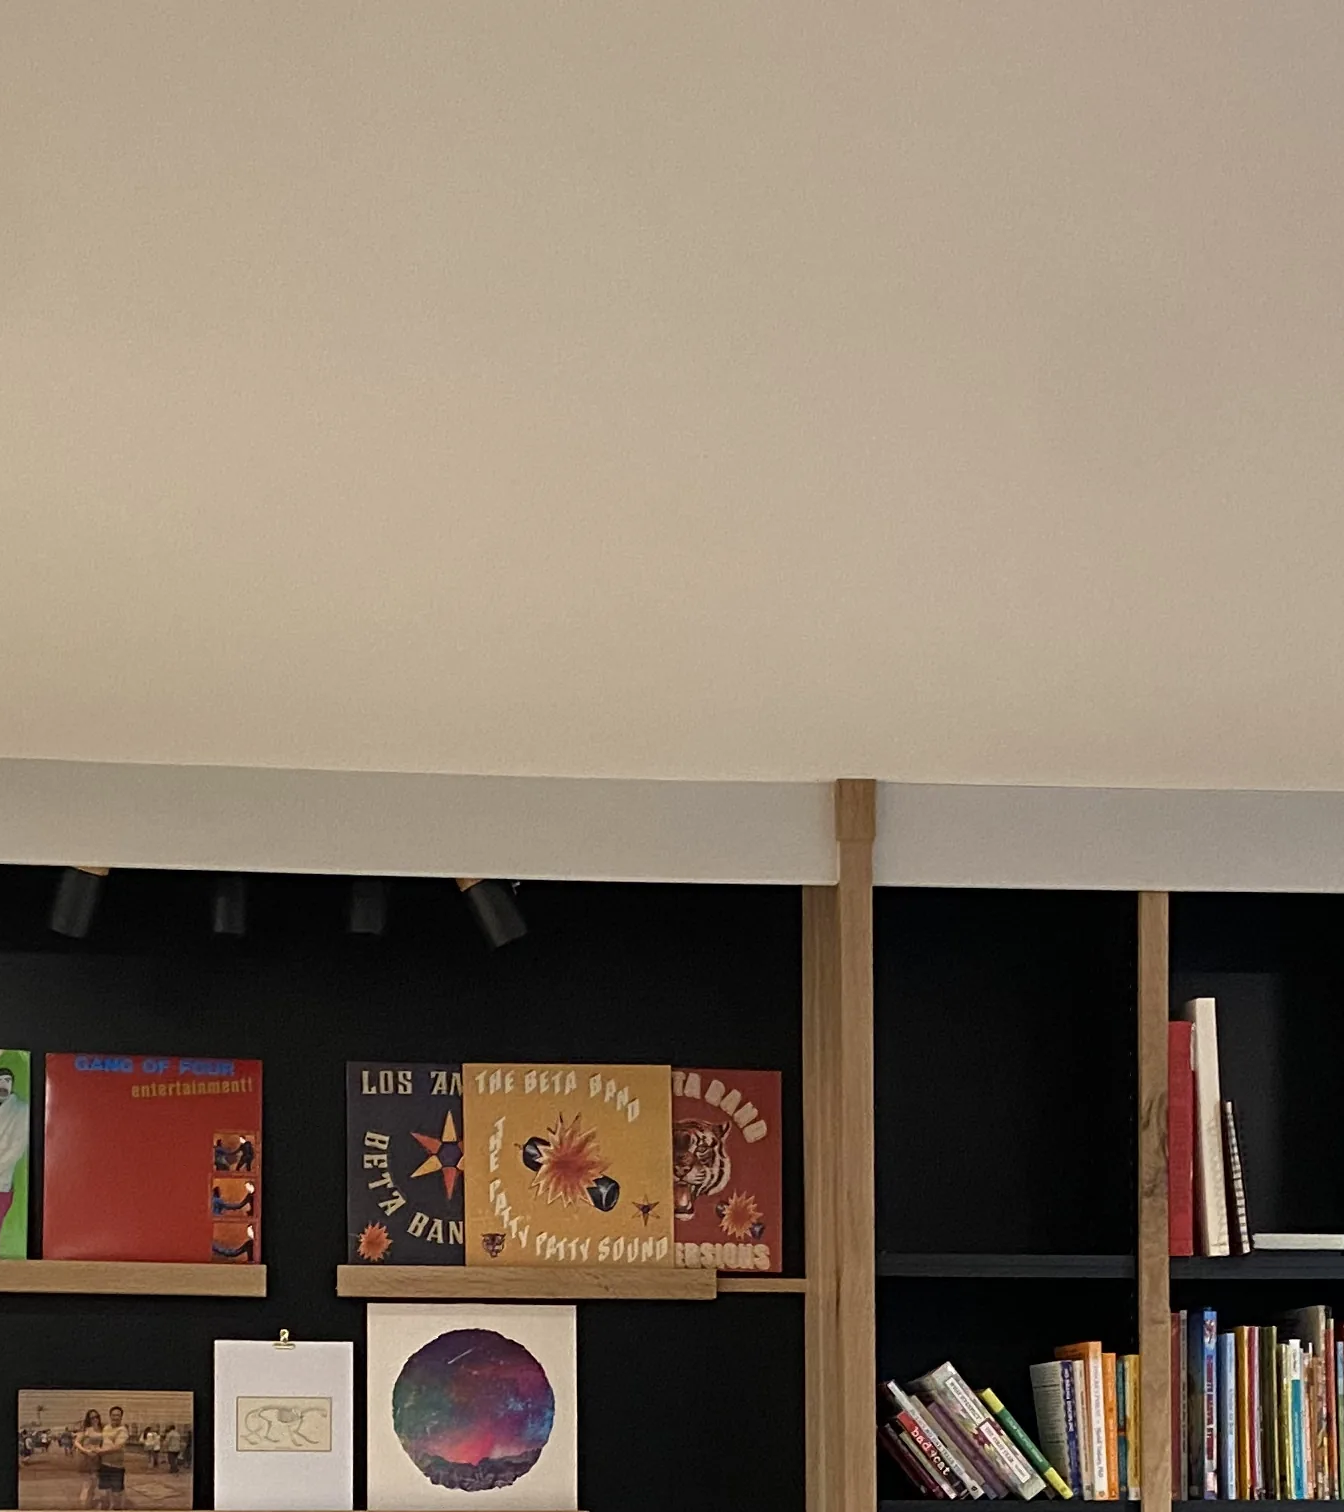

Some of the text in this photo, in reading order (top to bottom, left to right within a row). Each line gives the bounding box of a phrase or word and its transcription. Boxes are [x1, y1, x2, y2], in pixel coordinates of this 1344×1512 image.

[74, 1056, 234, 1076] GANG OF FOUR
[362, 1070, 413, 1095] LOS
[131, 1076, 253, 1098] entertainment!
[475, 1069, 640, 1122] THE BETA BAND
[672, 1071, 767, 1143] TA BAND
[363, 1131, 406, 1217] BETA
[489, 1116, 530, 1249] THE PATTY
[535, 1232, 668, 1263] PATTY SOUND
[676, 1242, 770, 1270] ERSIONS
[911, 1427, 951, 1477] bad cat
